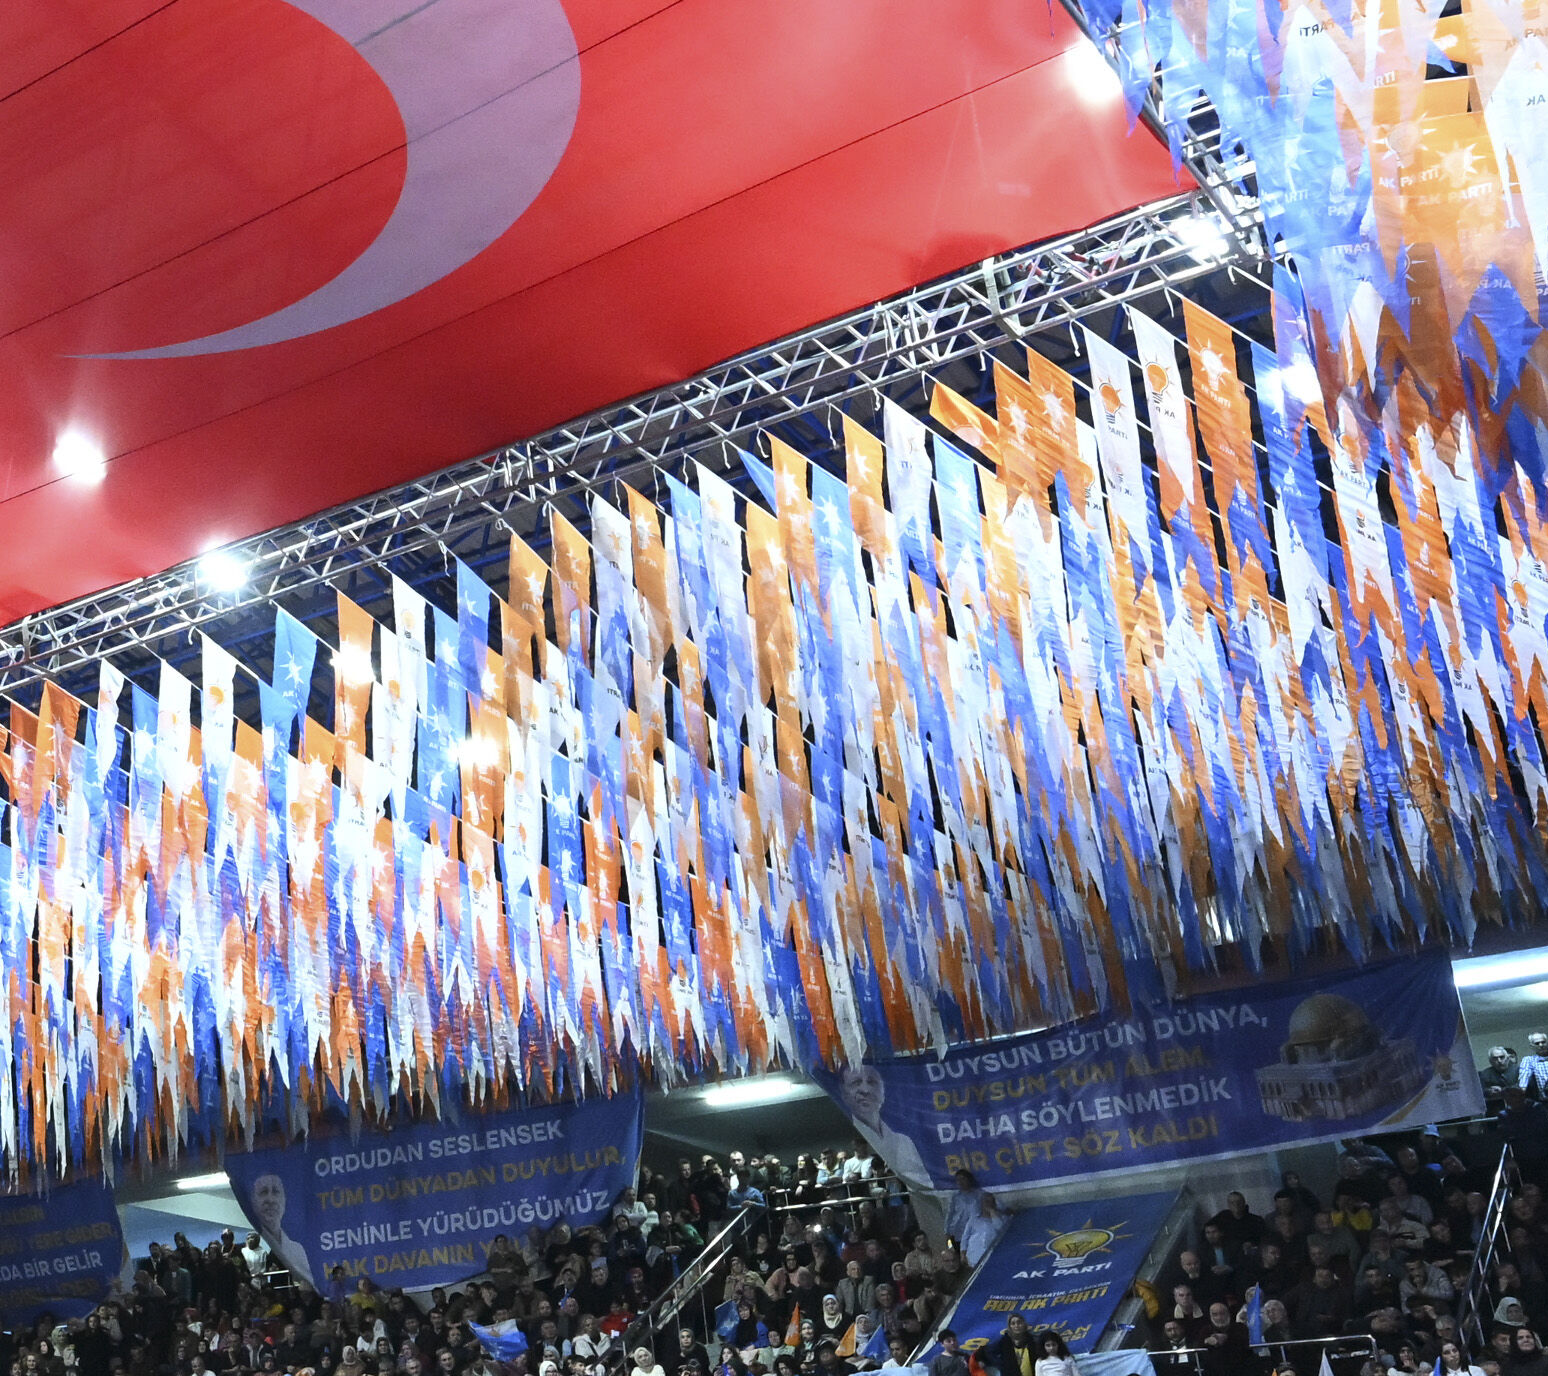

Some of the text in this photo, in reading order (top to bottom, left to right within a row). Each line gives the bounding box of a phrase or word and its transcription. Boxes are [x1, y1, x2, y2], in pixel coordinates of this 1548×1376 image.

[926, 1041, 1042, 1084] DUYSUN
[1051, 1017, 1147, 1057] BÜTÜN
[932, 1075, 1046, 1112] DUYSUN
[937, 1076, 1232, 1145] DAHA SÖYLENMEDİK
[314, 1120, 564, 1177] ORDUDAN SESLENSEK
[1064, 1123, 1120, 1159] SÖZ
[1129, 1115, 1220, 1147] KALDI
[316, 1186, 364, 1210] TÜM
[370, 1164, 497, 1203] DÜNYADAN
[320, 1188, 610, 1251] SENİNLE YÜRÜDÜĞÜMÜZ
[23, 1258, 52, 1276] BİR
[53, 1249, 103, 1274] GELİR
[374, 1241, 475, 1274] DAVANIN
